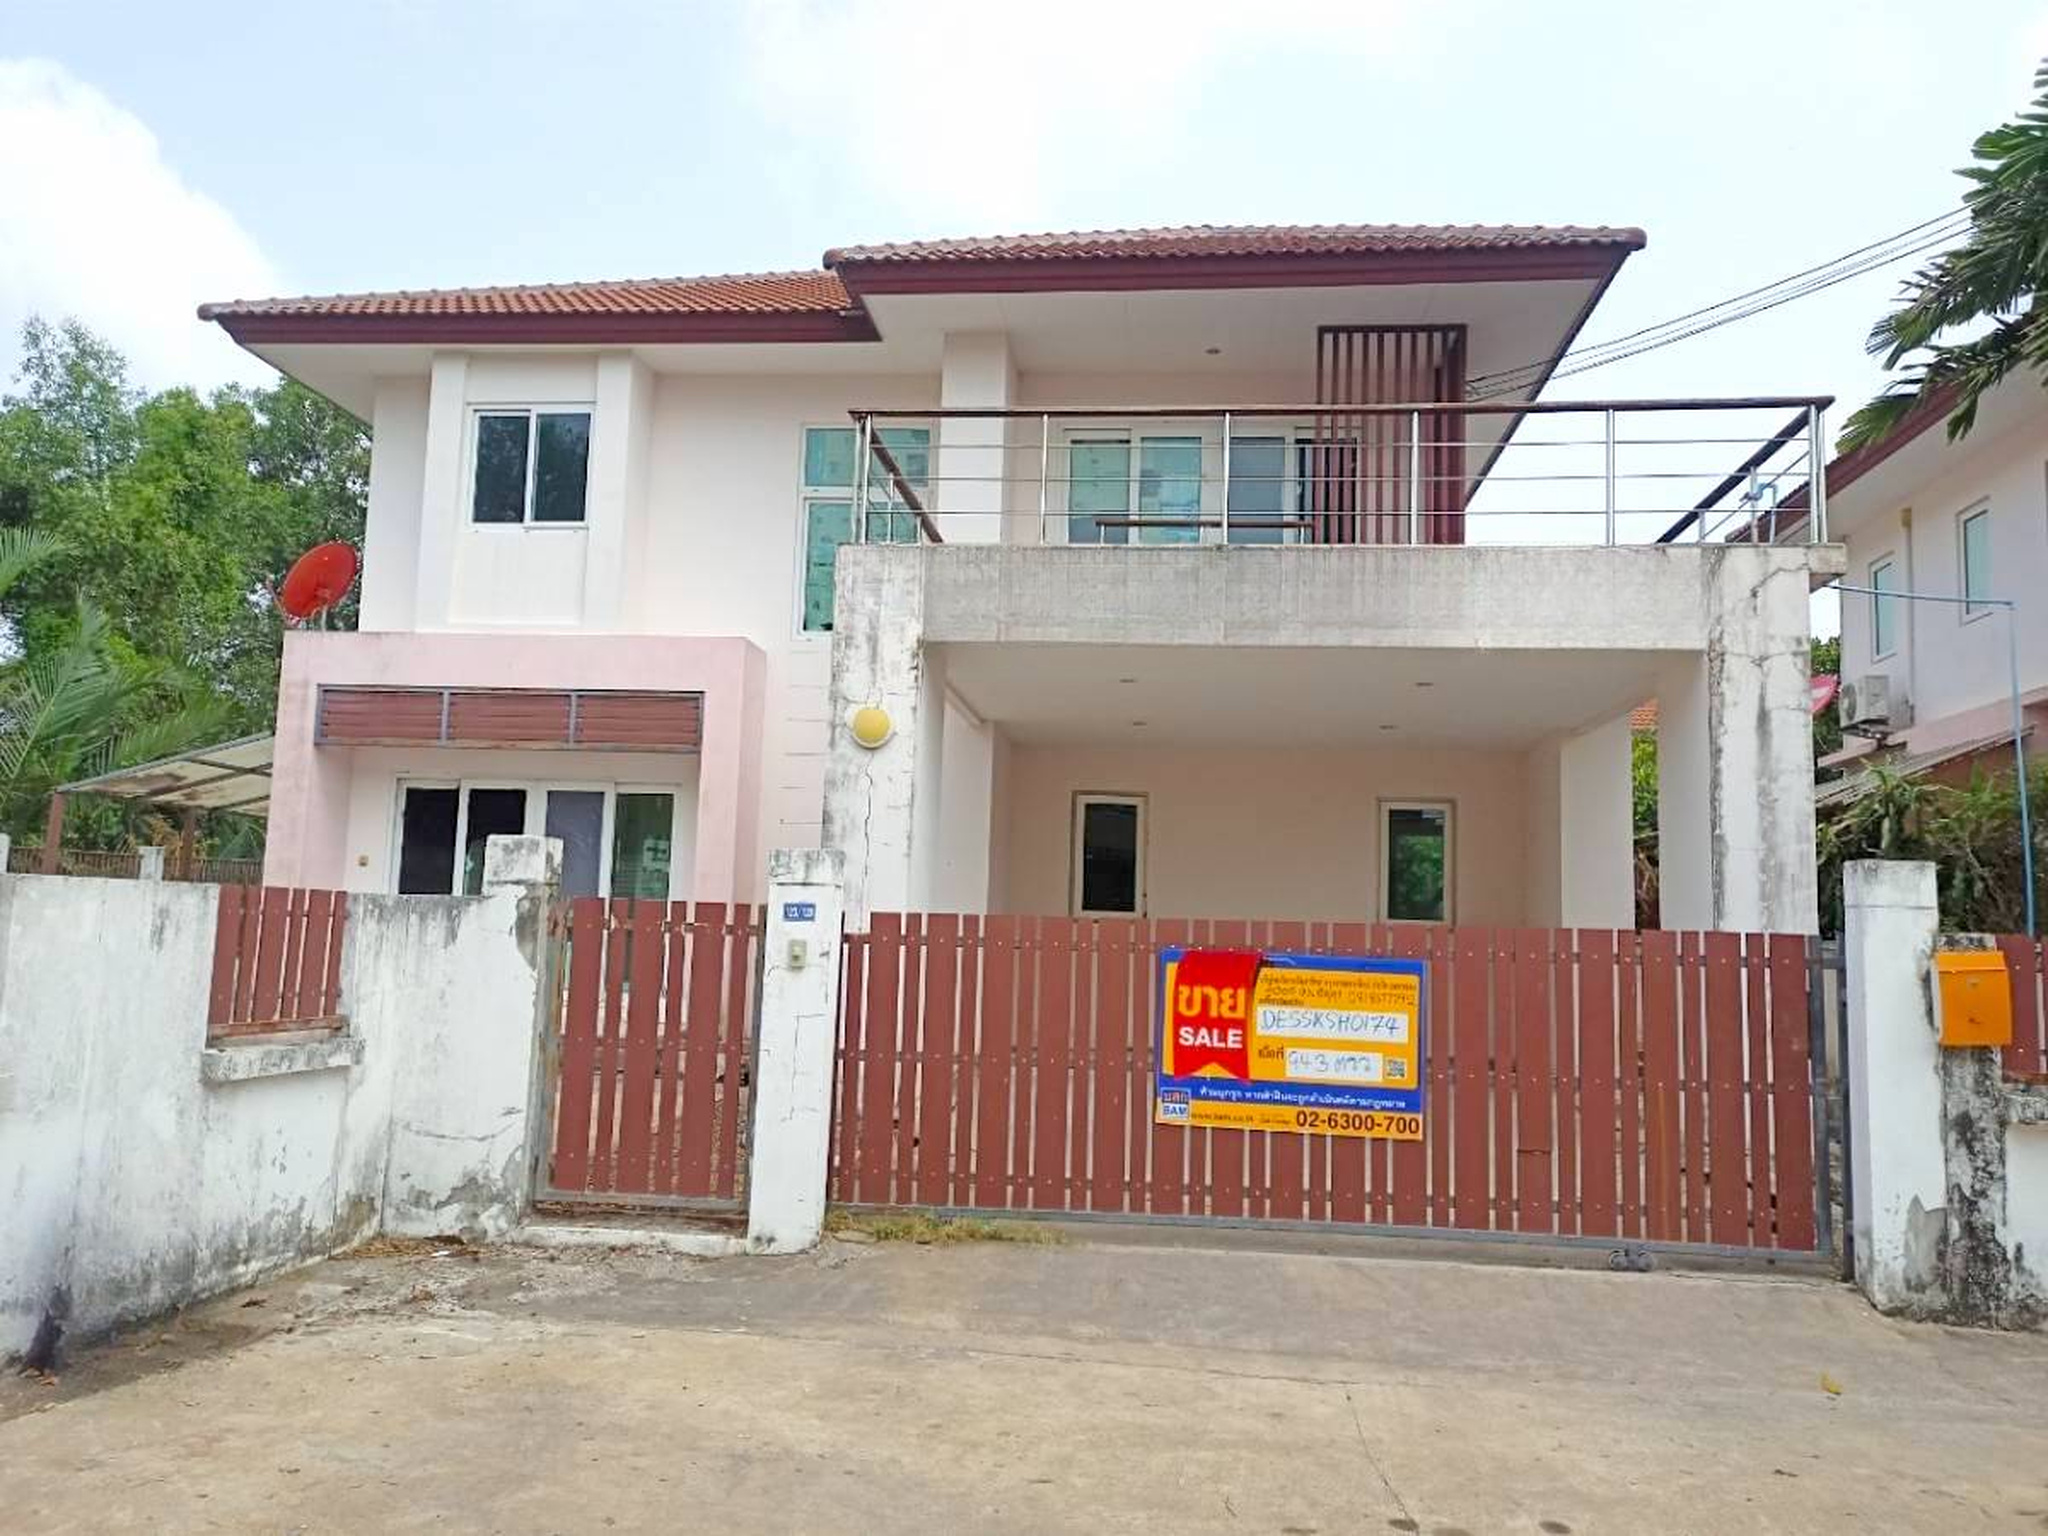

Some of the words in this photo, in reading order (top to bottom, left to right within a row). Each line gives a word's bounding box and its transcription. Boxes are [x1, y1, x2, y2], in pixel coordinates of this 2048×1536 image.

[1178, 984, 1245, 1018] ขาย
[1178, 1027, 1243, 1048] SALE
[1296, 1110, 1420, 1134] 02-6300-700
